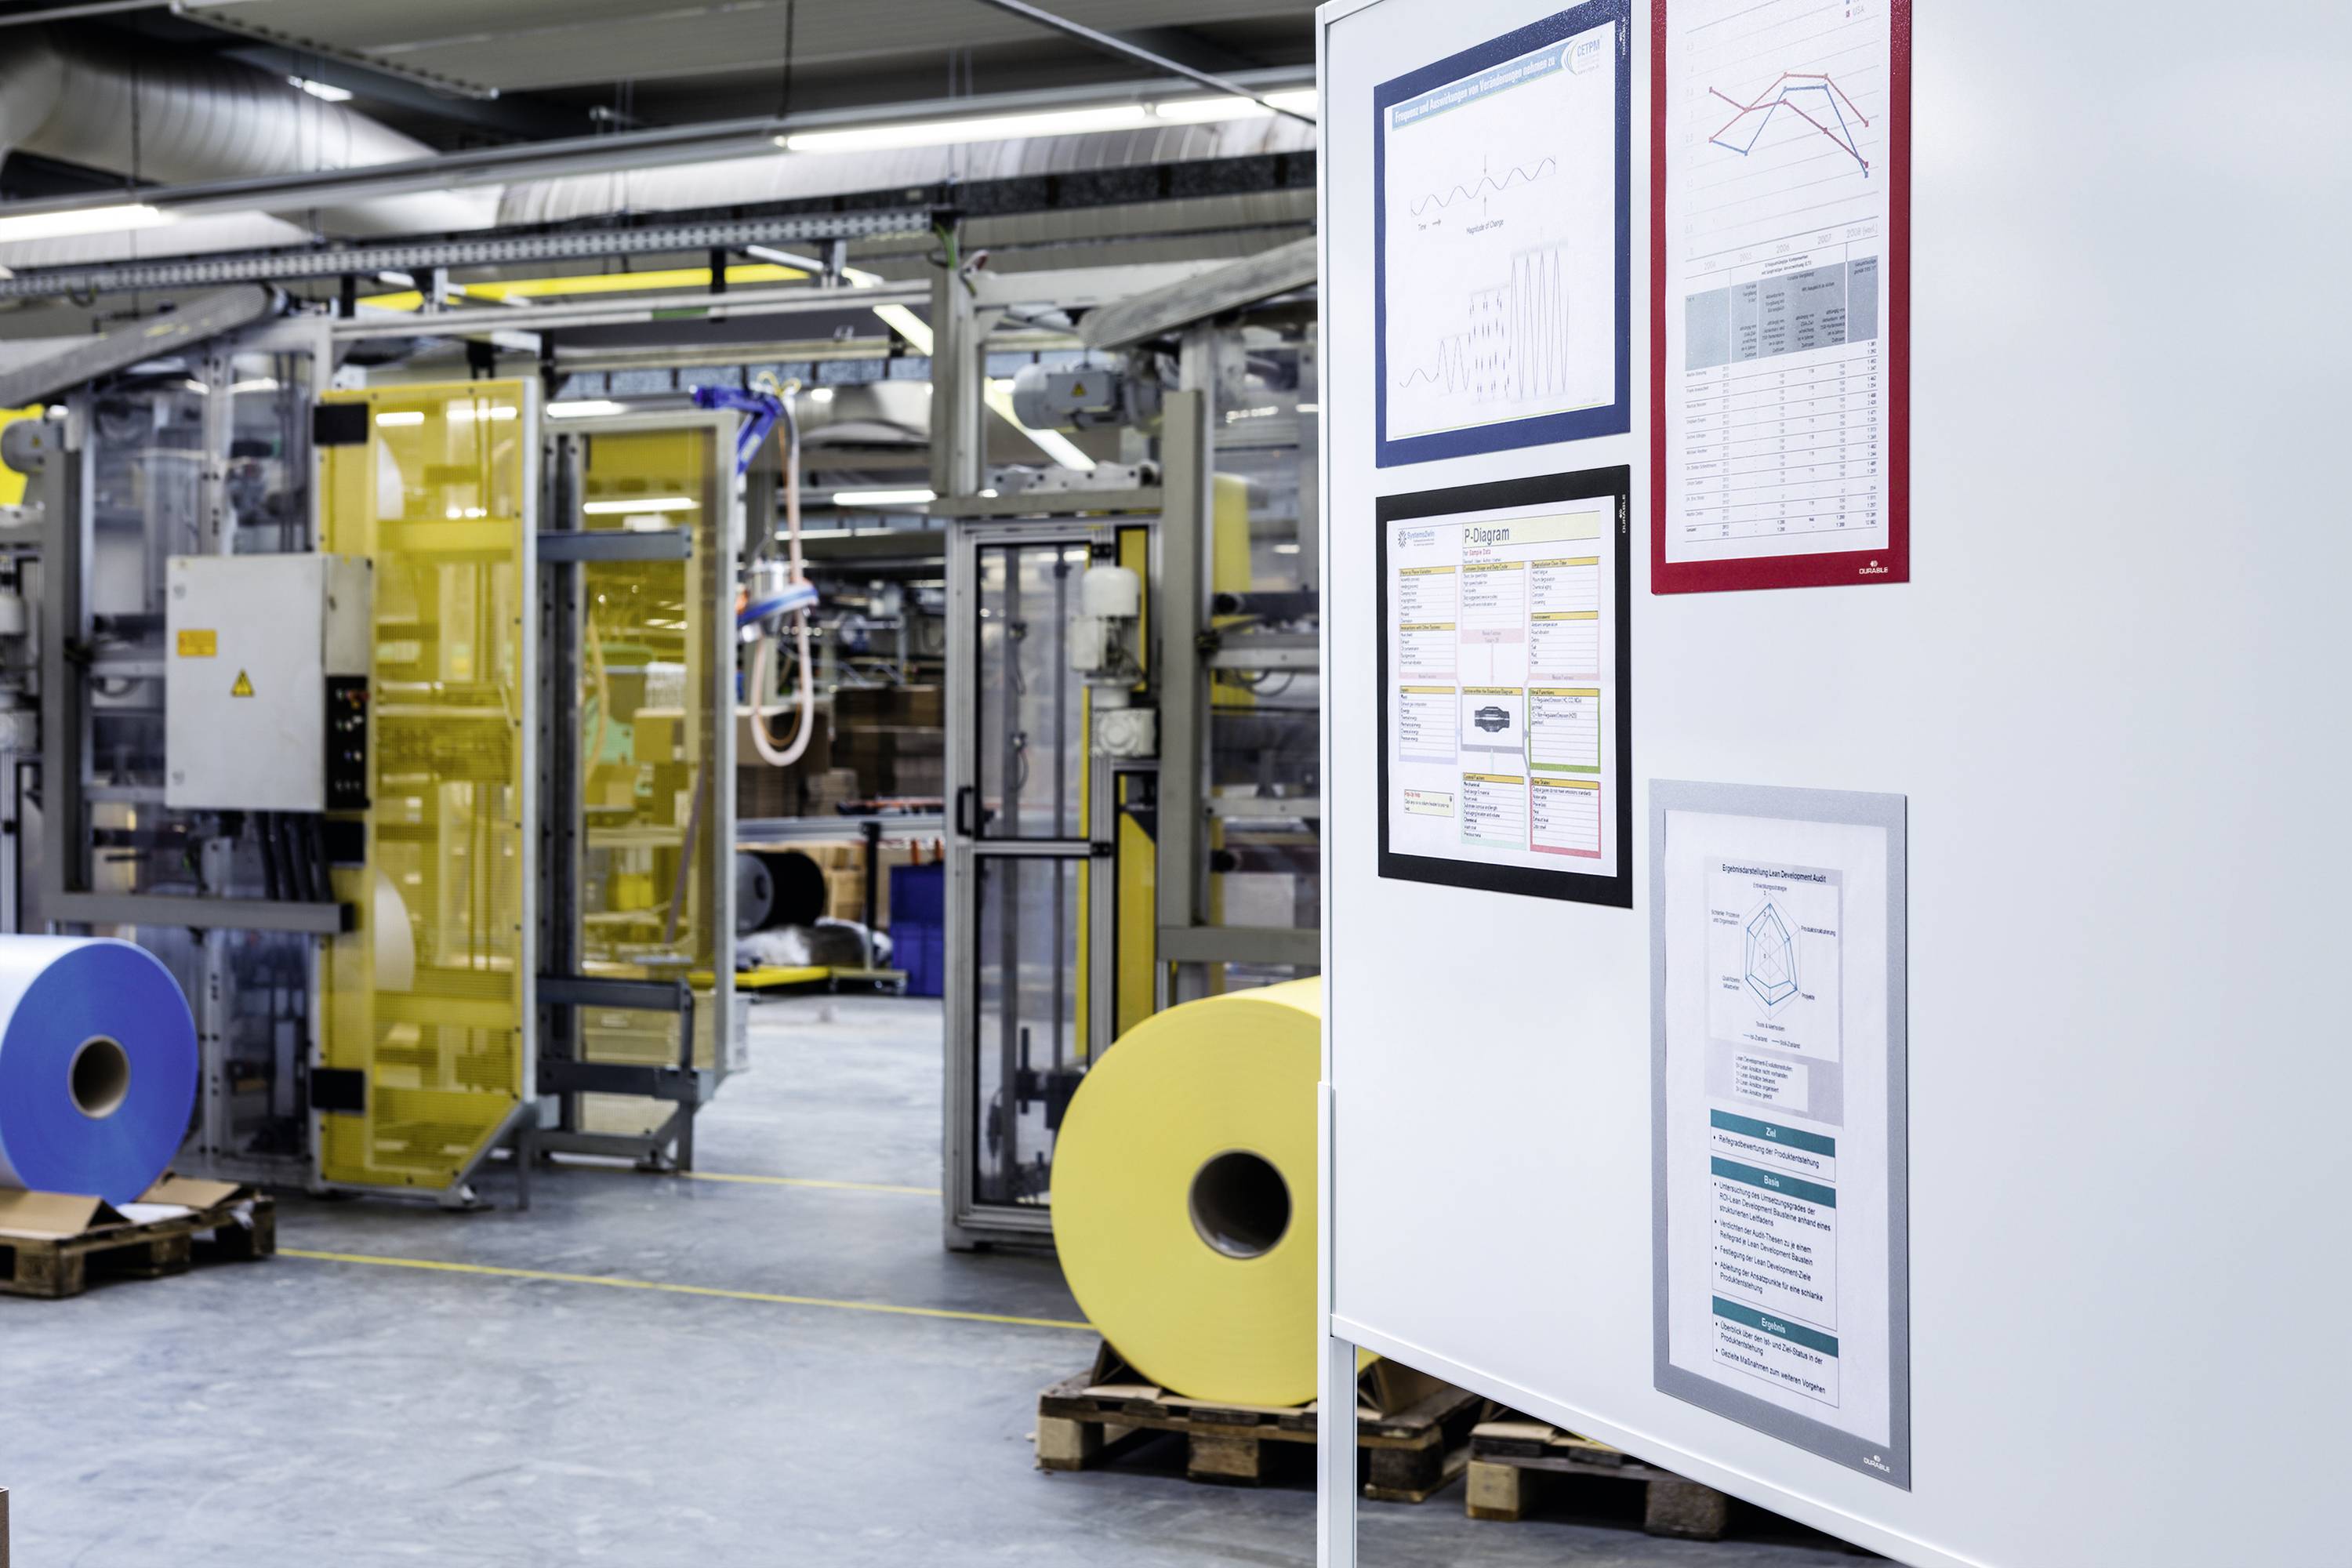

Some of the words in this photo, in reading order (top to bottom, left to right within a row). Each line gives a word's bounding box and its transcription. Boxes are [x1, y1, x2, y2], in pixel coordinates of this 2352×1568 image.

[1577, 38, 1600, 57] CETPM
[1419, 100, 1428, 114] und
[1430, 88, 1468, 112] Auswirkungen
[1468, 85, 1479, 96] von
[1523, 60, 1547, 77] nehmen
[1548, 56, 1555, 67] zu
[1465, 528, 1509, 545] P-Diagram
[1722, 864, 1768, 878] Ergebnisdarstellung
[1769, 869, 1780, 877] Lean
[1781, 870, 1812, 880] Development
[1766, 1126, 1776, 1138] Ziel
[1719, 1134, 1764, 1155] Reifegradbewertung
[1774, 1149, 1819, 1169] Produktentstehung
[1763, 1174, 1780, 1188] Basis
[1719, 1181, 1751, 1199] Untersuchung
[1761, 1194, 1806, 1213] Umsetzungsgrades
[1719, 1192, 1740, 1204] ROI-Lean
[1742, 1199, 1772, 1214] Development
[1773, 1207, 1796, 1221] Bausteine
[1798, 1217, 1816, 1227] anhand
[1817, 1222, 1831, 1231] eines
[1719, 1206, 1748, 1218] strukturierten
[1749, 1213, 1773, 1226] Leitfadens
[1719, 1219, 1743, 1233] Verdichten
[1752, 1229, 1783, 1244] Audit-Thesen
[1796, 1244, 1811, 1253] einem
[1720, 1230, 1741, 1243] Reifegrad
[1747, 1239, 1759, 1250] Lean
[1760, 1243, 1791, 1259] Development
[1791, 1253, 1813, 1265] Baustein
[1720, 1245, 1744, 1261] Festlegung
[1754, 1256, 1766, 1267] Lean
[1767, 1260, 1811, 1281] Development-Ziele
[1720, 1261, 1741, 1276] Ableitung
[1750, 1272, 1781, 1288] Ansatzpunkte
[1790, 1286, 1800, 1294] eine
[1801, 1290, 1823, 1301] schlanke
[1720, 1272, 1762, 1294] Produktentstehung
[1762, 1317, 1785, 1334] Ergebnis
[1721, 1321, 1741, 1335] Überblick
[1743, 1330, 1753, 1339] über
[1782, 1343, 1808, 1359] Ziel-Status
[1721, 1333, 1763, 1356] Produktentstehung
[1721, 1348, 1739, 1361] Gezielte
[1740, 1356, 1769, 1372] Maßnahmen
[1781, 1373, 1801, 1385] weiteren
[1802, 1379, 1825, 1393] Vorgehen
[1863, 1457, 1890, 1473] DURABLE
